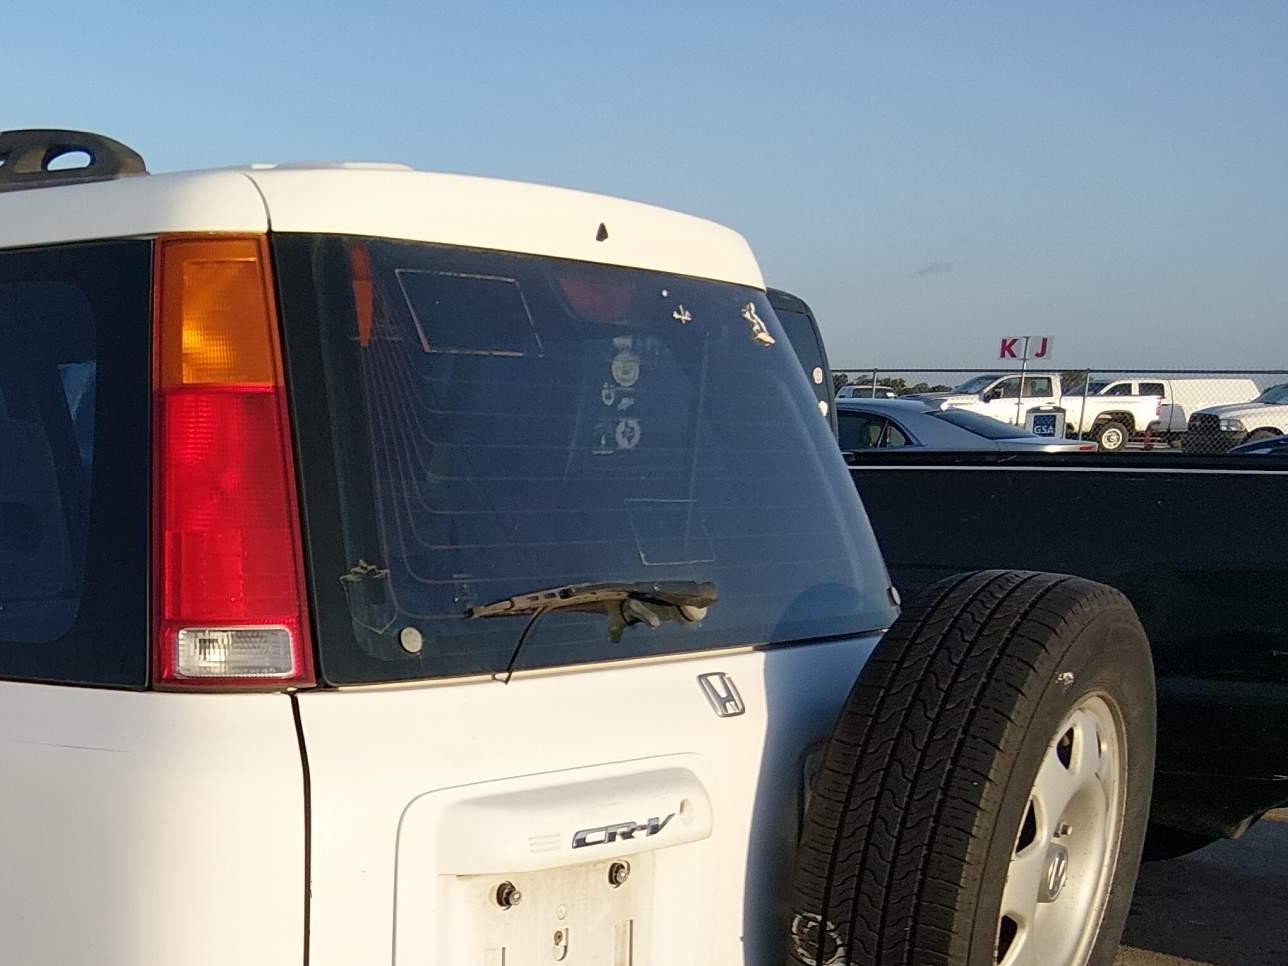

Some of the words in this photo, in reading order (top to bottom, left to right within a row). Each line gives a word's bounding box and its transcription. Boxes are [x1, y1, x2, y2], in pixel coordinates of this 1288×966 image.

[999, 338, 1019, 359] K
[1034, 337, 1048, 358] J
[1033, 424, 1054, 434] GSA
[571, 812, 676, 849] CR-V
